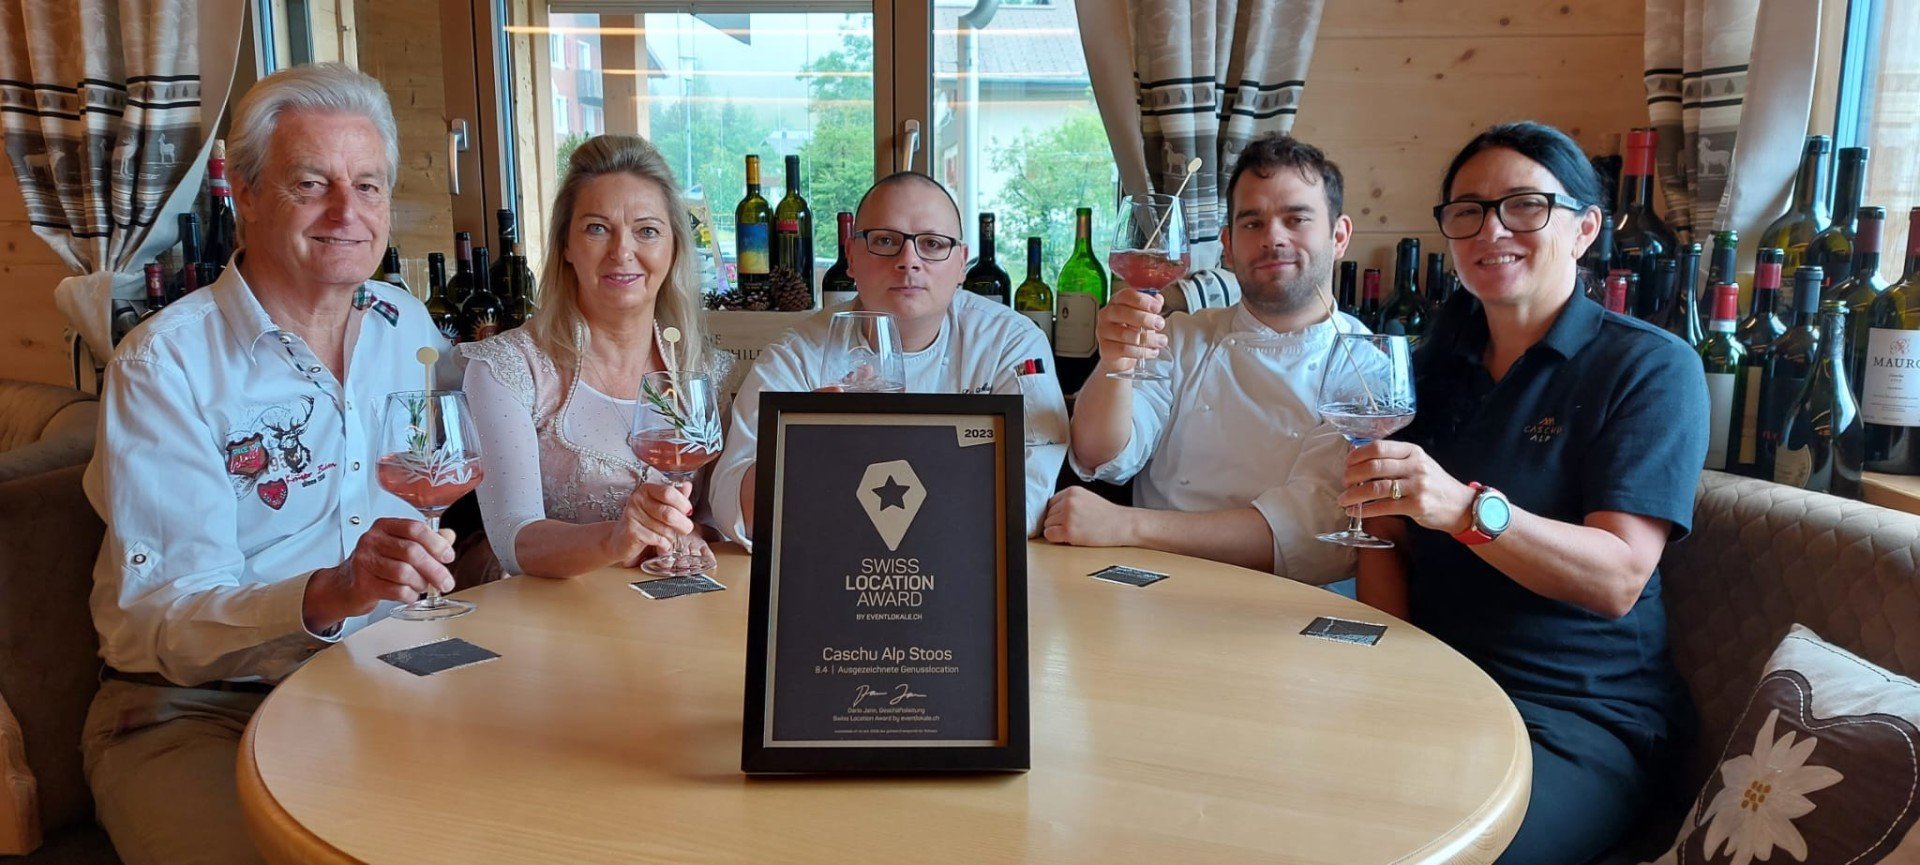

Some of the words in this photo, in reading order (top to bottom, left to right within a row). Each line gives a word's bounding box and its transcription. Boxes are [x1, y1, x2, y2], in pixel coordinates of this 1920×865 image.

[722, 349, 763, 360] HIL
[964, 429, 994, 438] 2023
[861, 558, 920, 574] SWISS
[845, 575, 935, 591] LOCATION
[856, 591, 922, 607] AWARD
[822, 646, 878, 661] Caschu
[881, 646, 905, 664] Alp
[909, 646, 953, 661] Stoos
[815, 665, 828, 674] 8.4
[837, 665, 899, 675] Ausgezeichnete
[900, 664, 959, 674] Genusslocation
